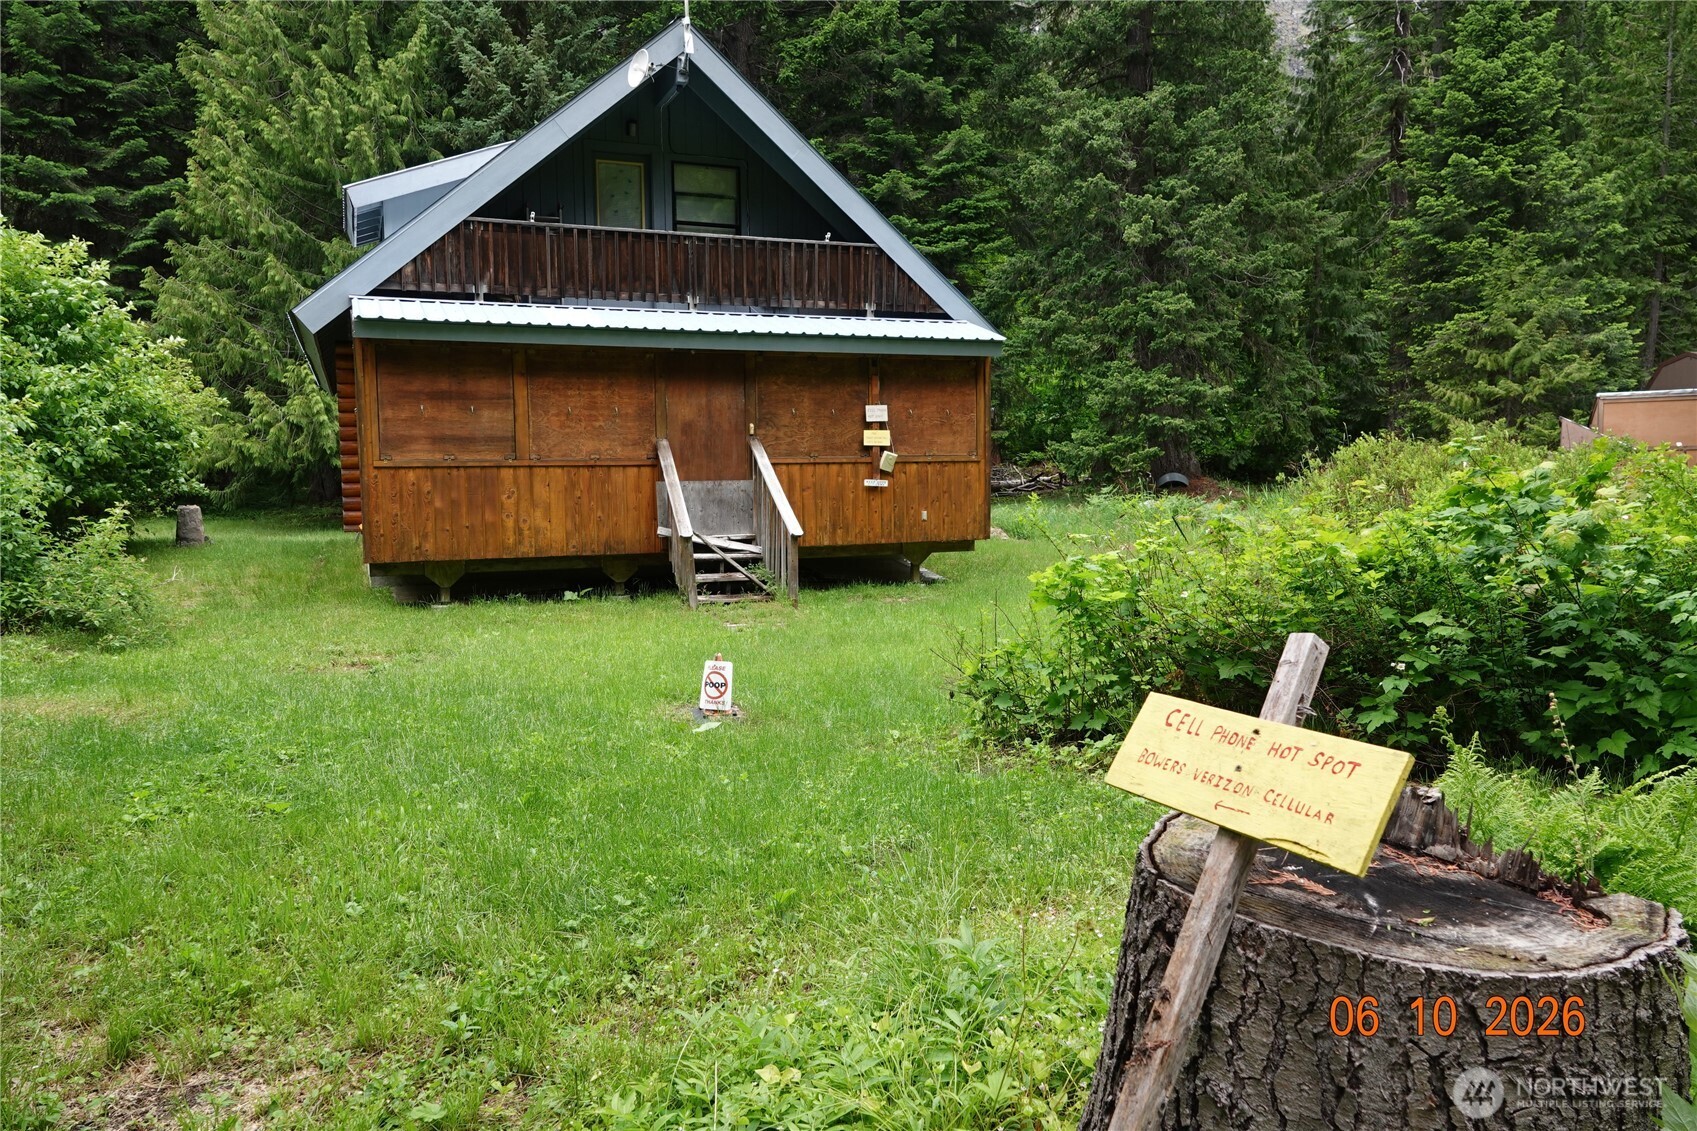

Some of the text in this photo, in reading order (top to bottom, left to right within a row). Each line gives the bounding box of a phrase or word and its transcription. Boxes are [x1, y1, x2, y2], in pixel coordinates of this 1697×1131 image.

[705, 681, 726, 689] POOP
[1165, 708, 1362, 780] CELL PHONE HOT SPOT
[1137, 747, 1335, 825] BOWERS VERIZON CELLULAR
